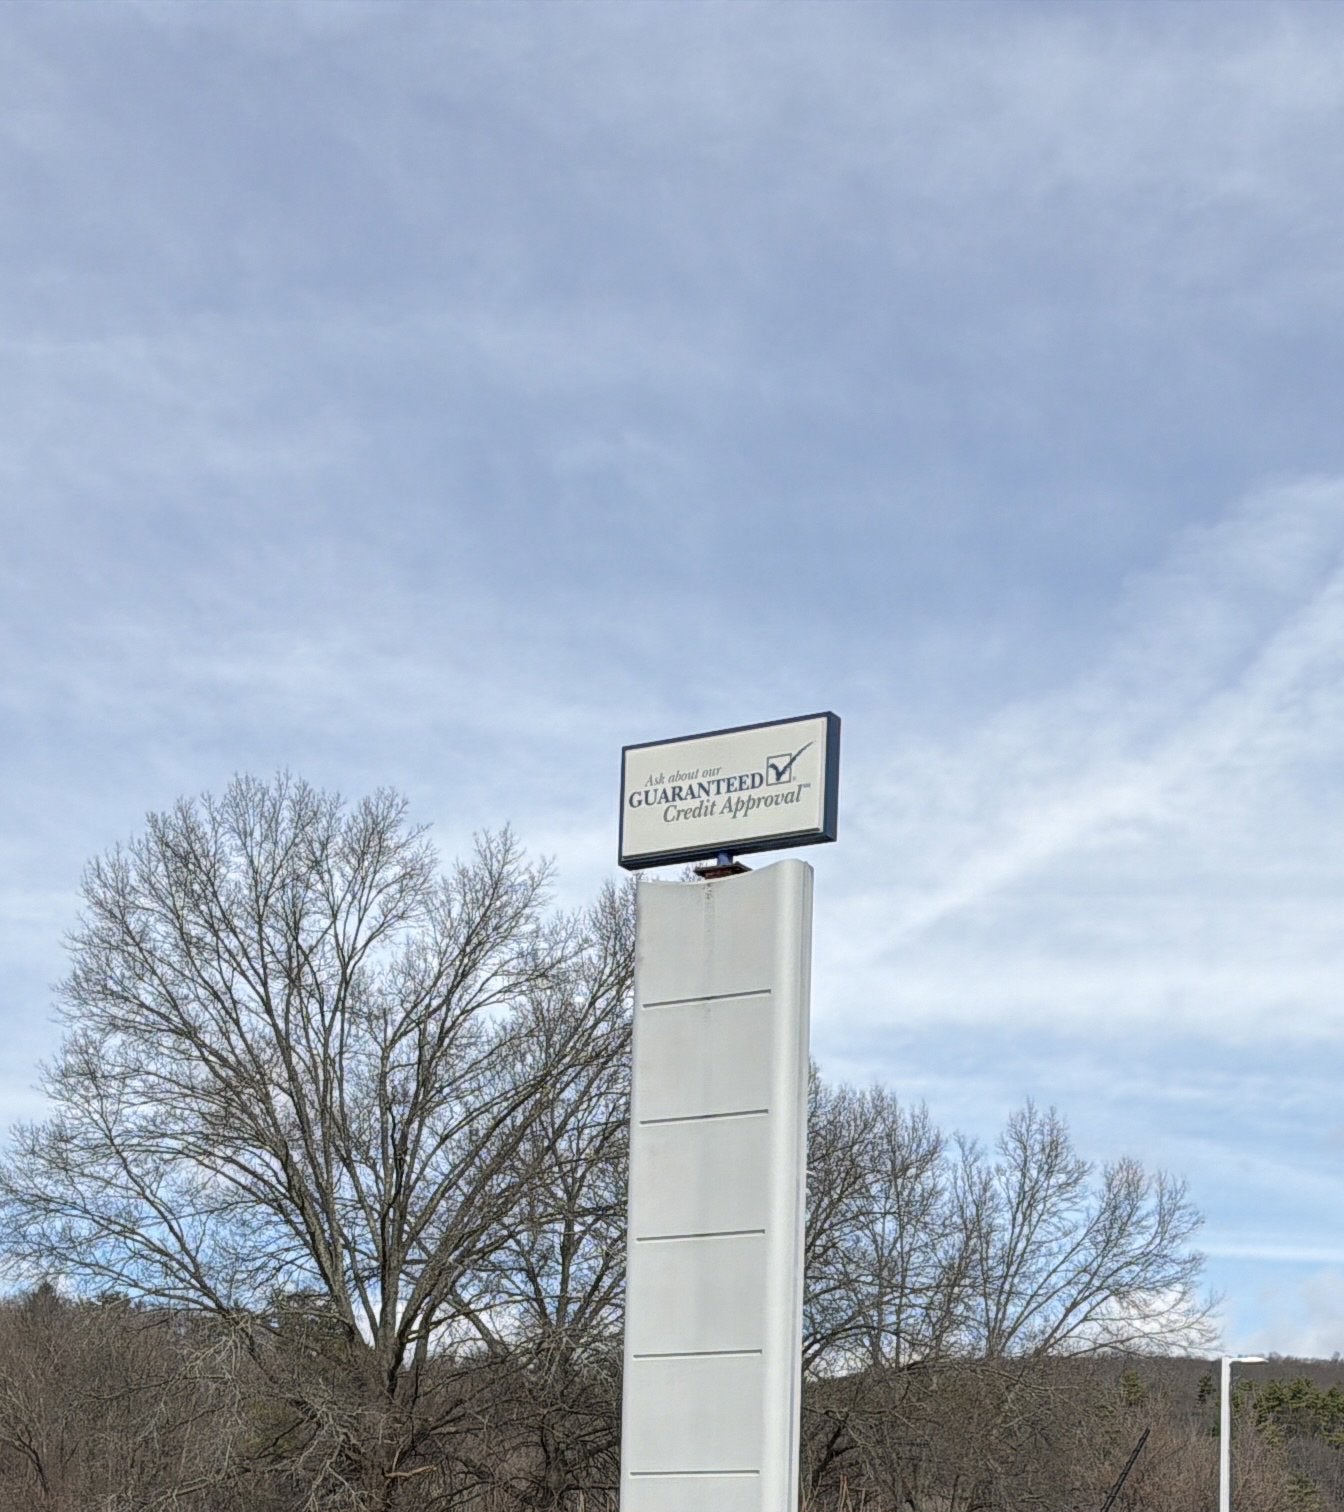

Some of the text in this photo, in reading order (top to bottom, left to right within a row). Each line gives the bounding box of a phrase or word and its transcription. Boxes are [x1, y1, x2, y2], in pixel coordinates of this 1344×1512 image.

[645, 767, 722, 787] Ask about our
[629, 772, 764, 808] GUARANTEED
[663, 802, 716, 823] Credit
